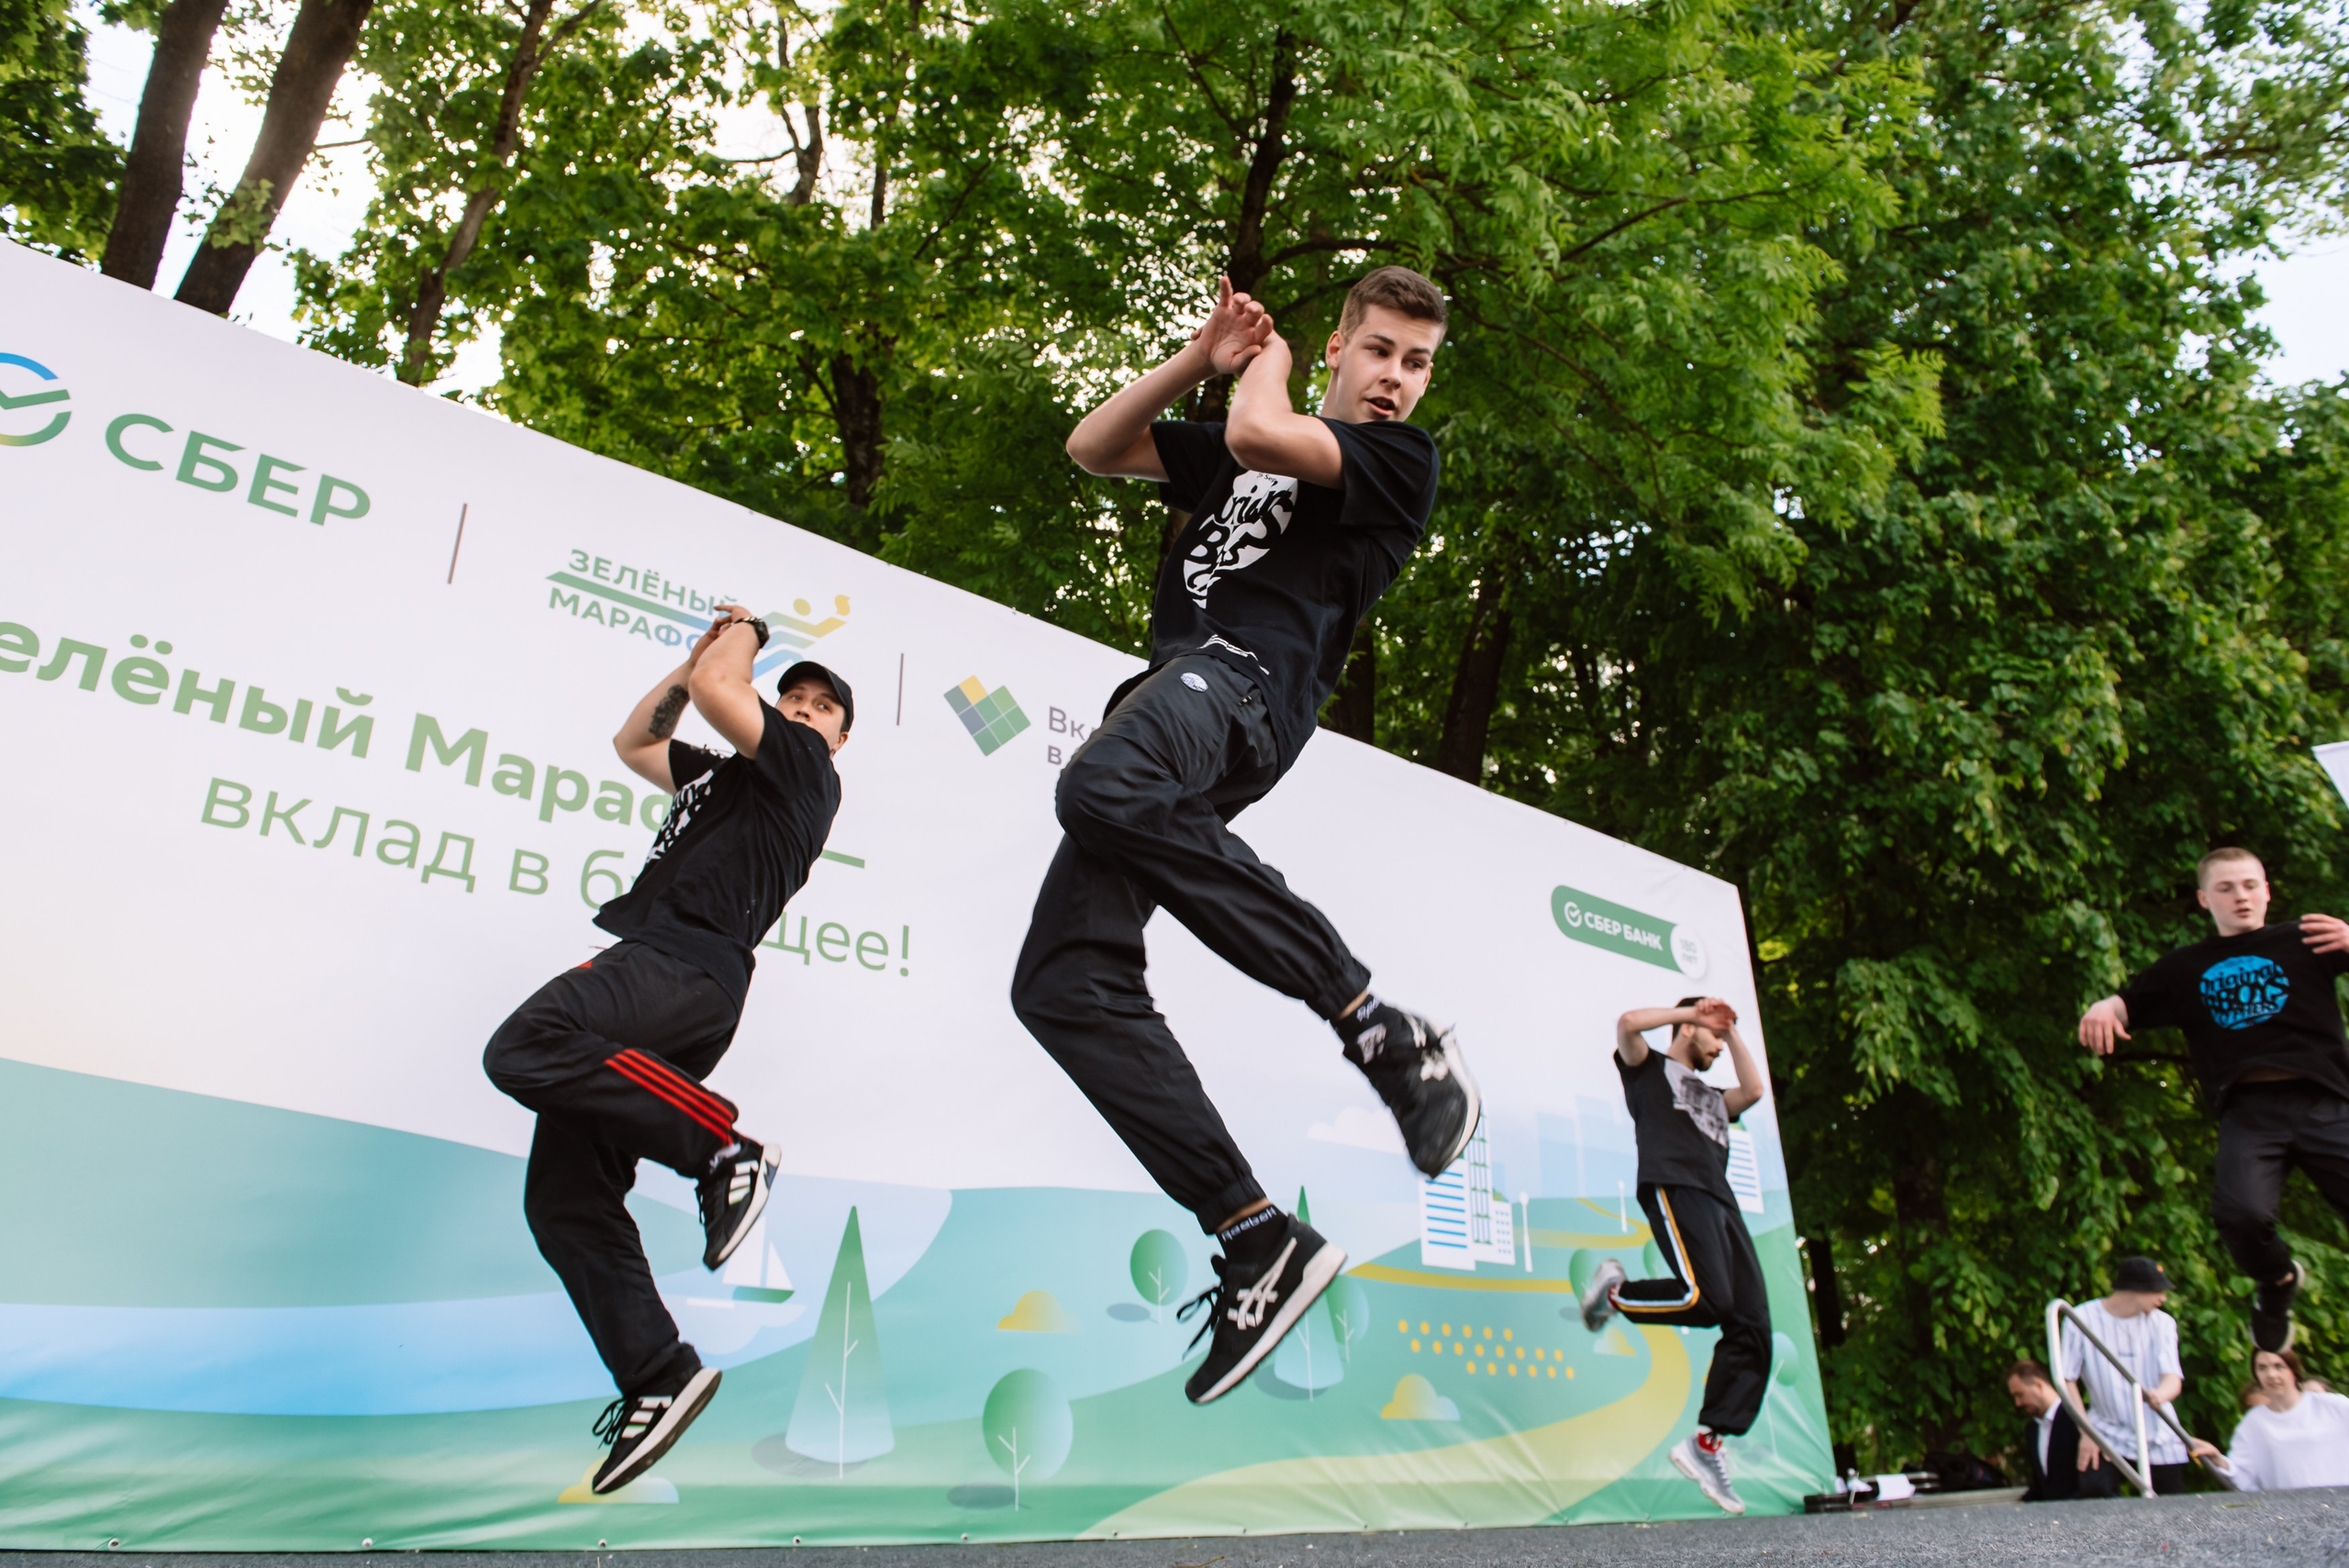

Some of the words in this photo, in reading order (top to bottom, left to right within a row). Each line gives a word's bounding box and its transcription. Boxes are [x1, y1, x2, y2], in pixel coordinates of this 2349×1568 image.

[105, 412, 372, 527] СБЕР
[548, 587, 702, 657] МАРАФ
[405, 712, 674, 834] Мара
[200, 776, 476, 894] вклад
[508, 848, 551, 896] в
